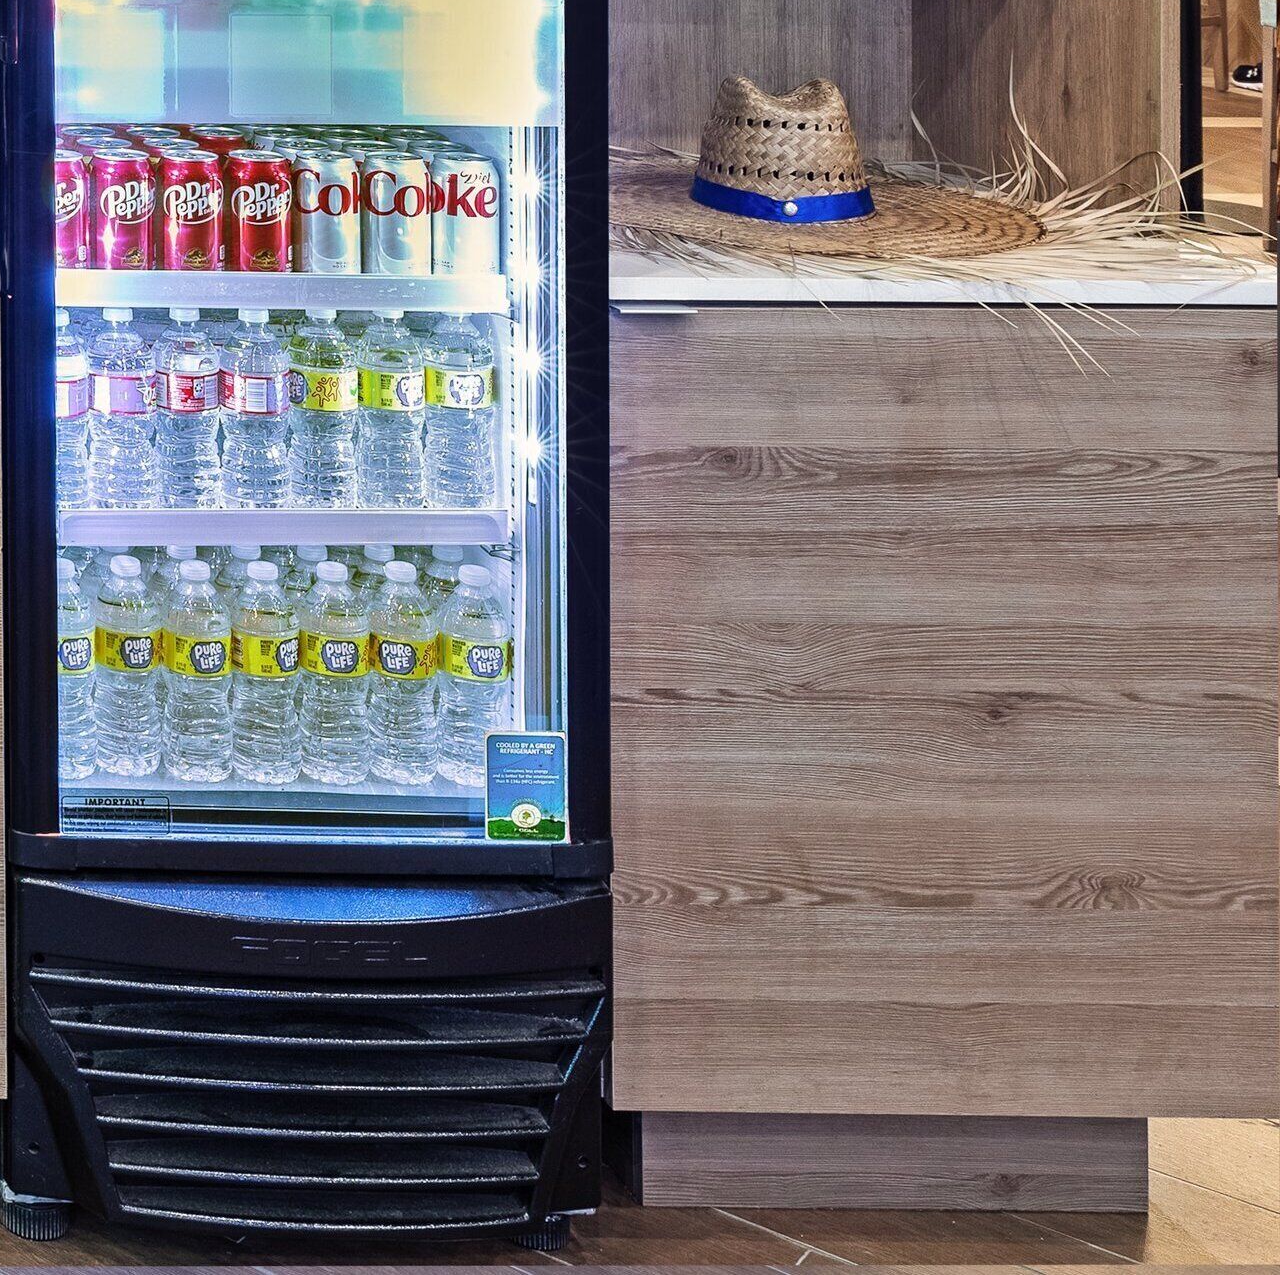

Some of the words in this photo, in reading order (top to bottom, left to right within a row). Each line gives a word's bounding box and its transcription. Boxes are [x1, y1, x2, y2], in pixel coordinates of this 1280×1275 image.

[460, 171, 492, 185] Diet
[187, 181, 210, 200] Dr
[256, 181, 279, 200] Dr
[164, 184, 224, 221] Peppr
[85, 798, 146, 806] IMPORTANT
